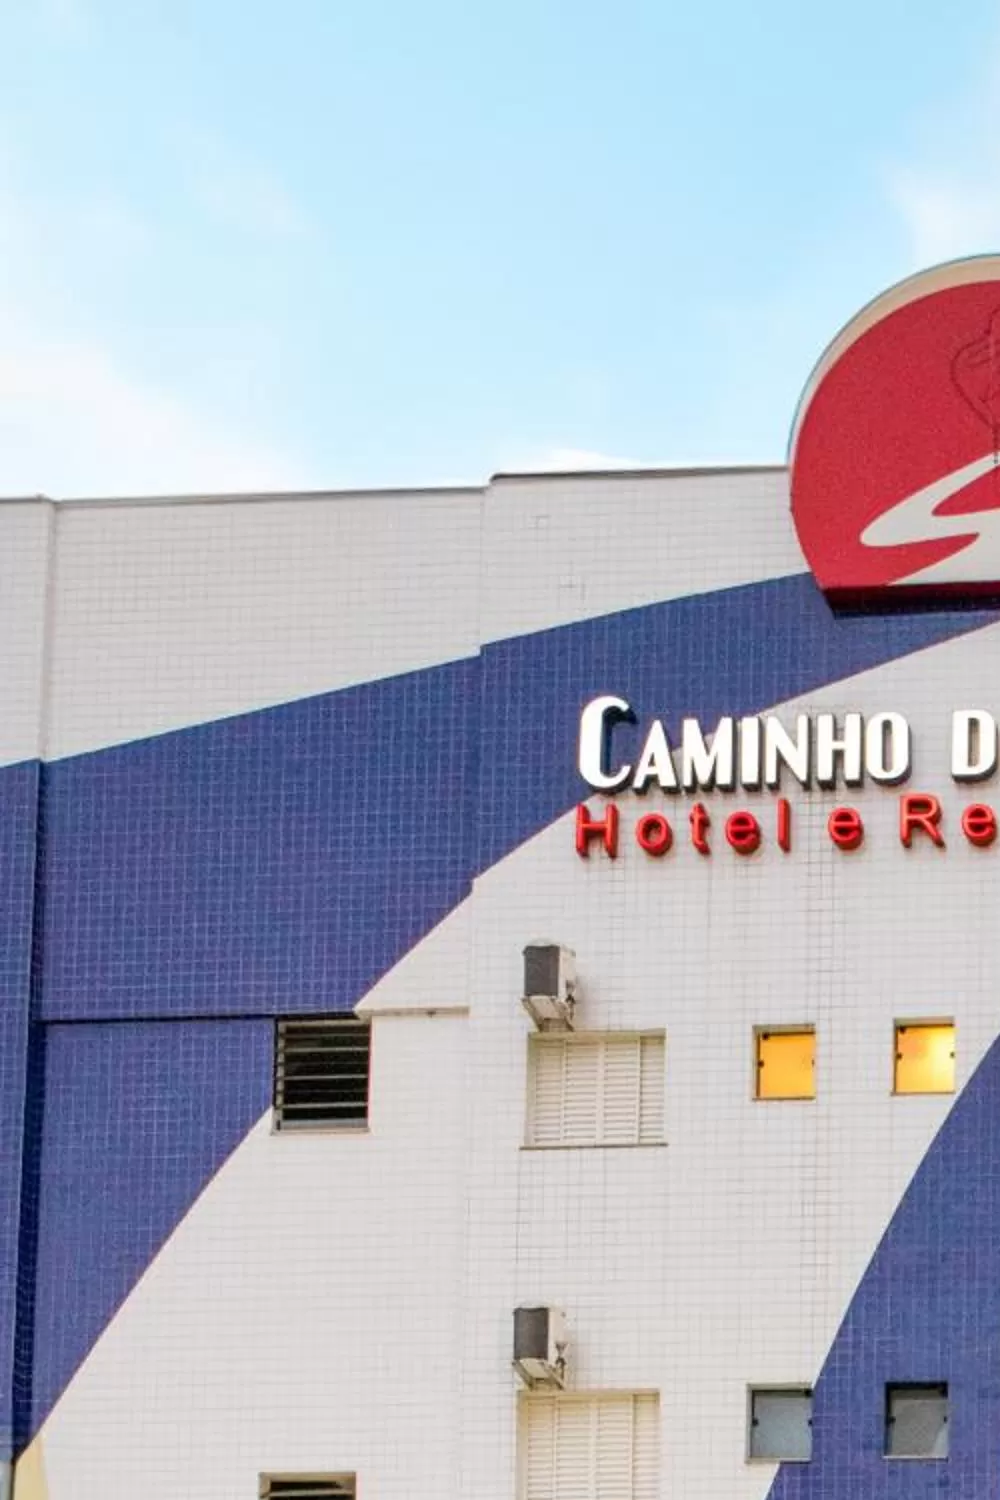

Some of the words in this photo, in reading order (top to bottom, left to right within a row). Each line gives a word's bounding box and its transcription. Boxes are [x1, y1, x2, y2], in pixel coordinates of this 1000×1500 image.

[578, 695, 912, 794] CAMINHO
[574, 797, 793, 858] Hotel
[827, 806, 864, 850] e
